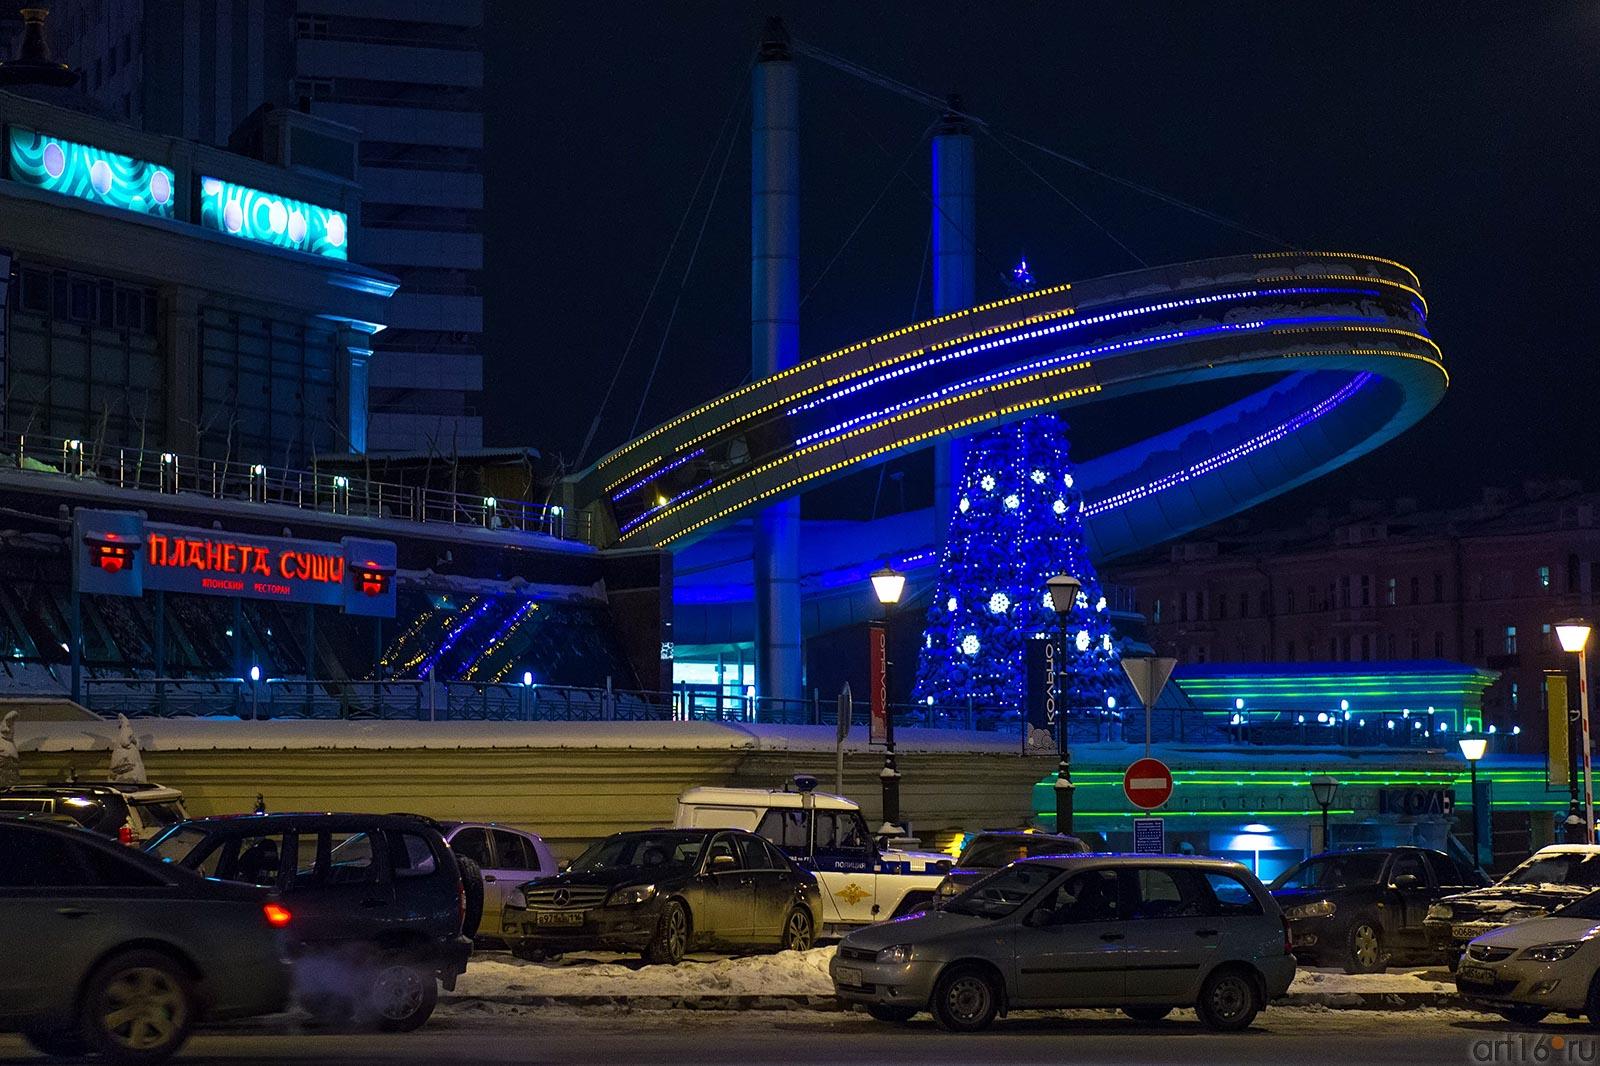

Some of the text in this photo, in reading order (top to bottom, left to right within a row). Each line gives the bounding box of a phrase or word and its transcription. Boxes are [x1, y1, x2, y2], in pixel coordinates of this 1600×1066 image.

[149, 532, 345, 584] ПЛАНЕТА СУШИ
[202, 578, 290, 595] ЯПОНСКИЙ РЕСТОРАН
[879, 632, 887, 714] КОЛЬЦО
[1044, 642, 1056, 726] КОЛЬЦО
[834, 860, 866, 869] ПОЛИЦИЯ
